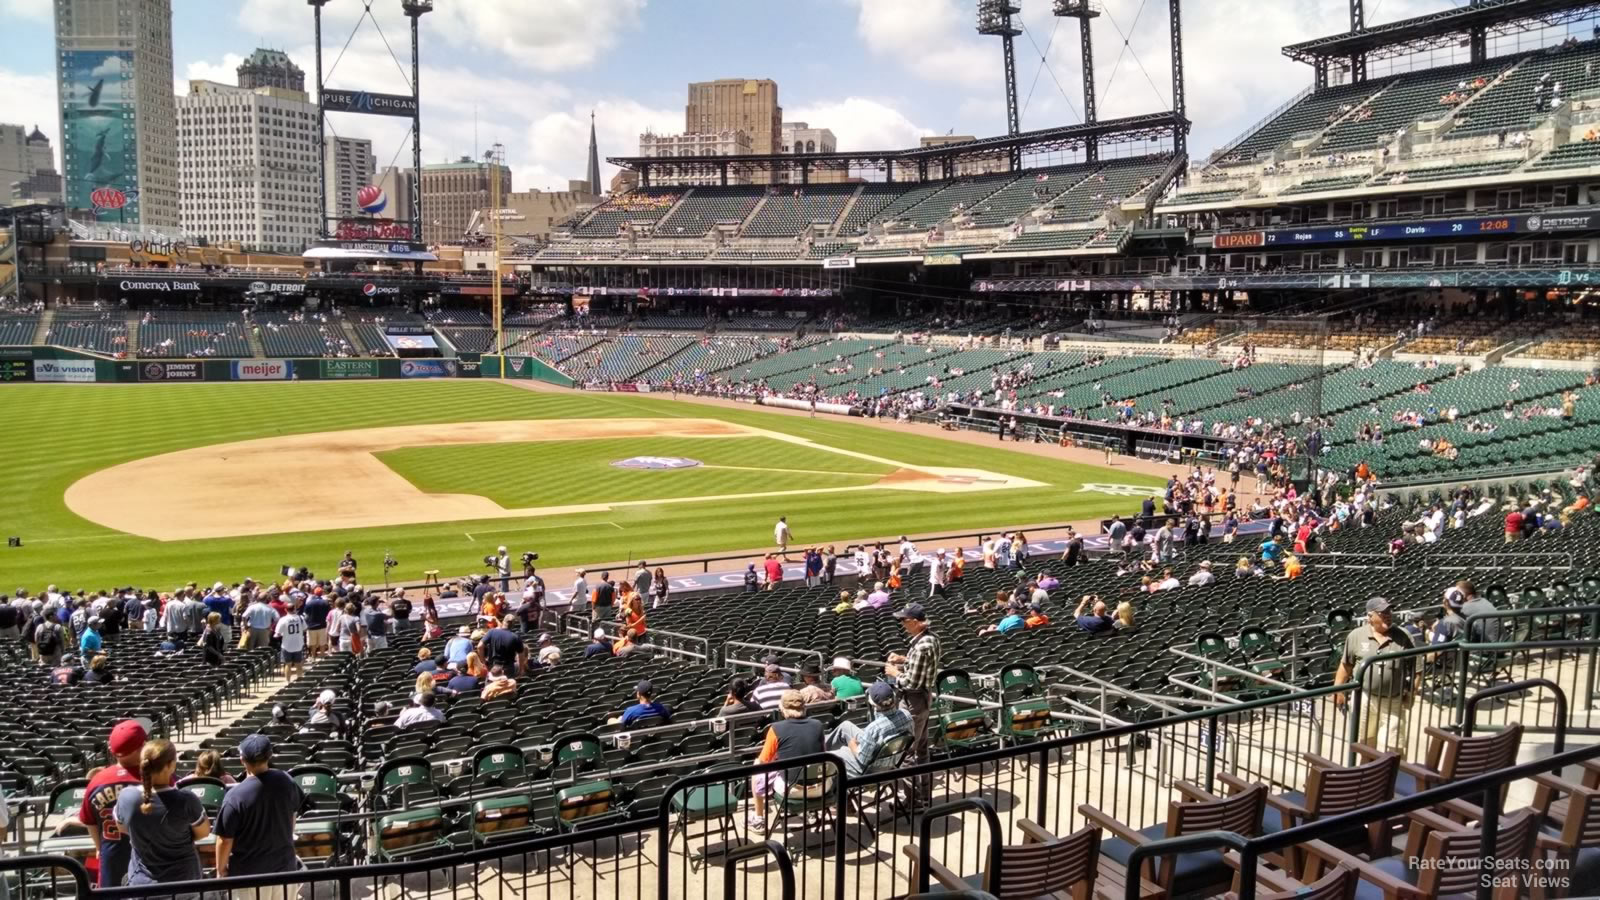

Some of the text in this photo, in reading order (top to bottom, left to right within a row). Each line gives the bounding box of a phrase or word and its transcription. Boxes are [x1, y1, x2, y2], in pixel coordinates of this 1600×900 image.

[324, 90, 416, 110] PURE MICHIGAN
[94, 189, 122, 207] AAA
[1542, 216, 1590, 227] DETROIT
[1267, 234, 1276, 242] 72
[1294, 233, 1312, 241] Rojas
[1334, 230, 1344, 238] SS
[1371, 228, 1380, 236] LF
[1405, 226, 1425, 234] Davis
[1452, 224, 1463, 232] 20
[1480, 220, 1508, 230] 12:08
[1219, 235, 1257, 247] LIPARI
[354, 242, 389, 252] AMSTERDAM
[173, 281, 200, 291] Bank
[270, 283, 306, 292] DETROIT
[377, 286, 400, 294] pepsi
[166, 363, 196, 371] JIMMY
[242, 362, 282, 376] meijer
[327, 360, 372, 369] EASTERN
[288, 623, 300, 635] 01
